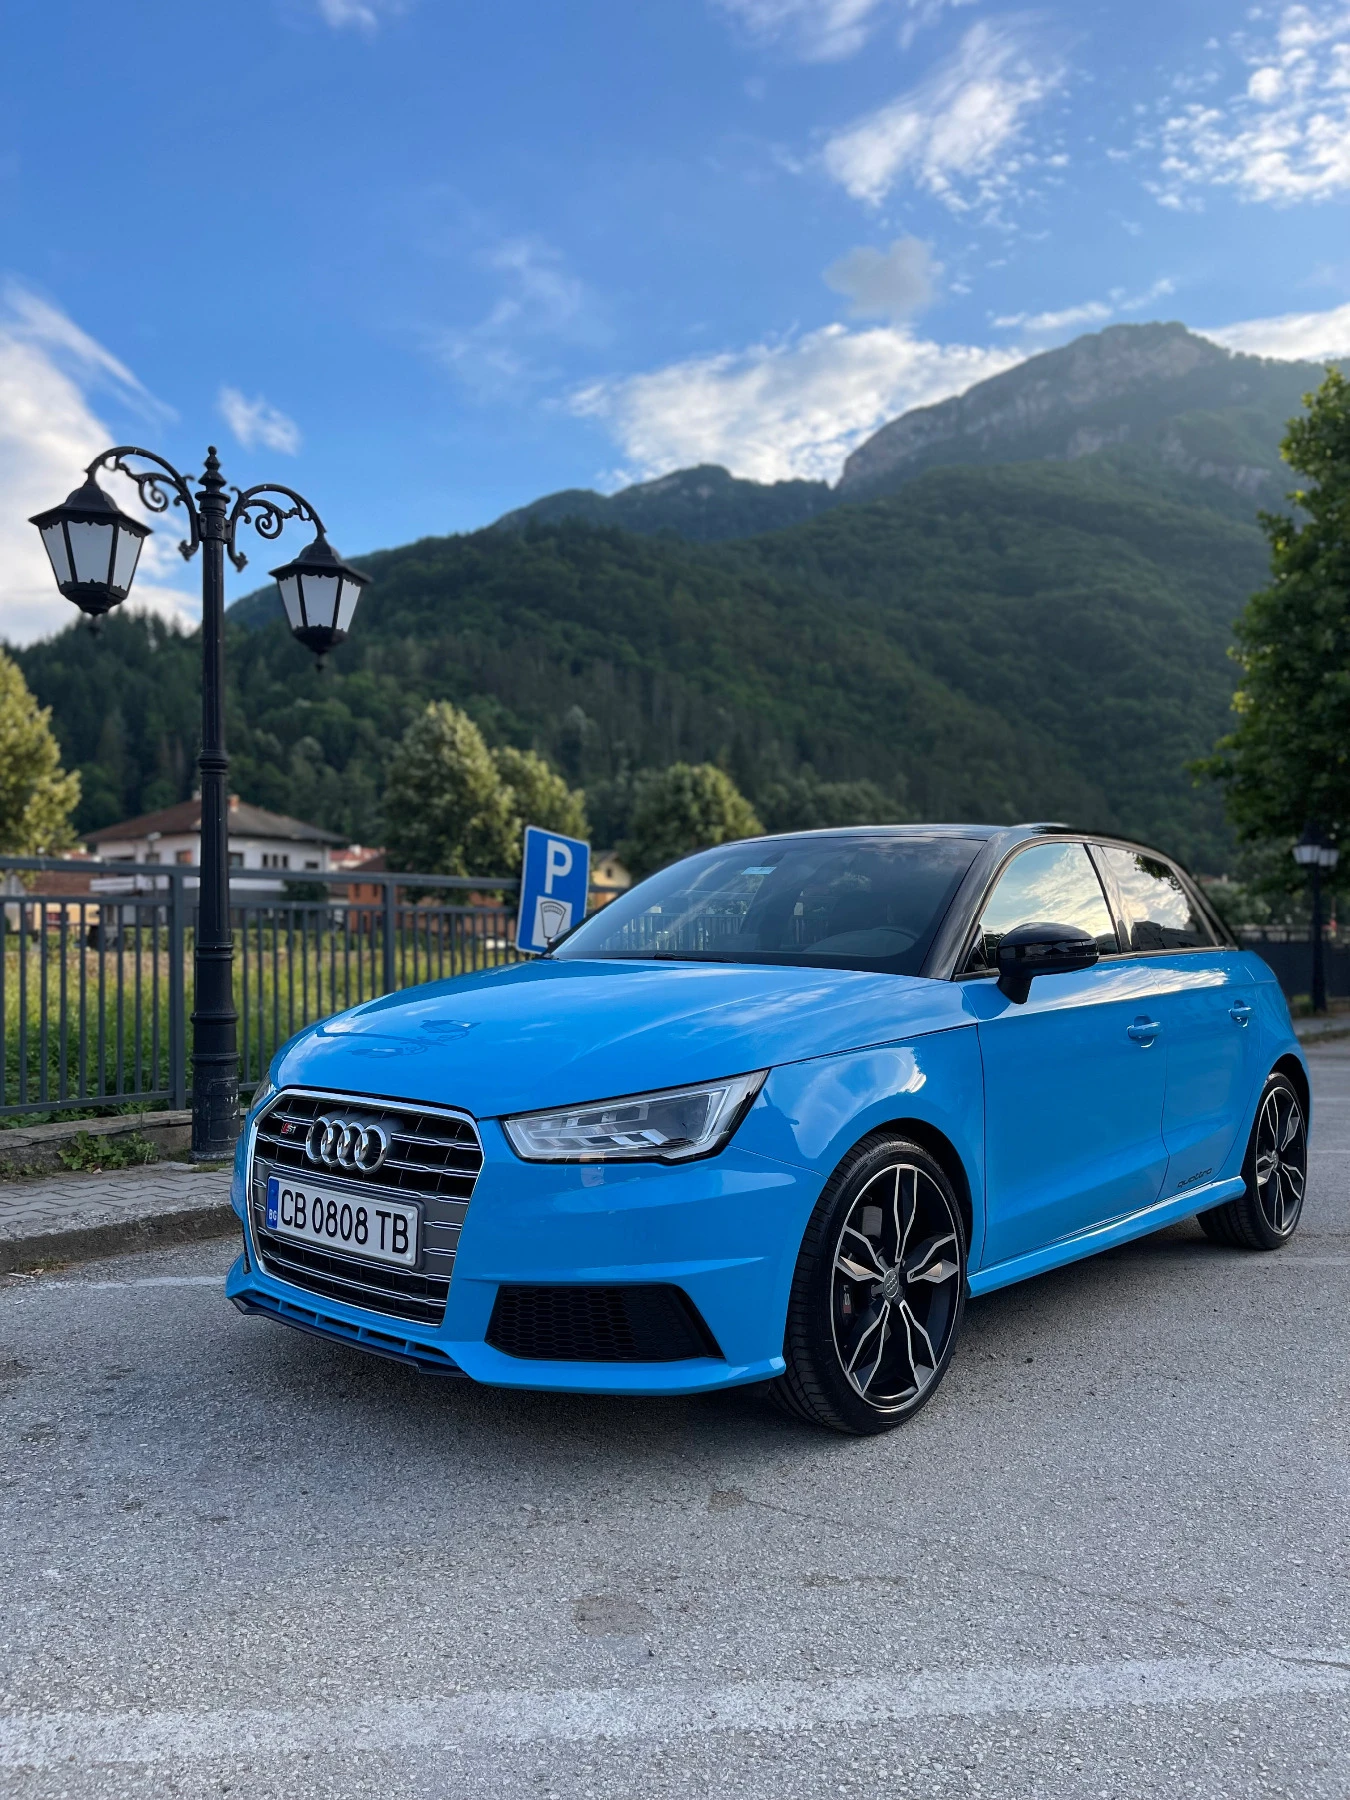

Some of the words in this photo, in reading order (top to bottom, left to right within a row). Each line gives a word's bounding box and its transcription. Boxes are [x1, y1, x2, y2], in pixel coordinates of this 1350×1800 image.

[544, 839, 573, 894] P
[268, 1208, 277, 1221] BG
[281, 1189, 307, 1229] CB
[311, 1196, 369, 1245] 0808
[375, 1210, 409, 1254] TB
